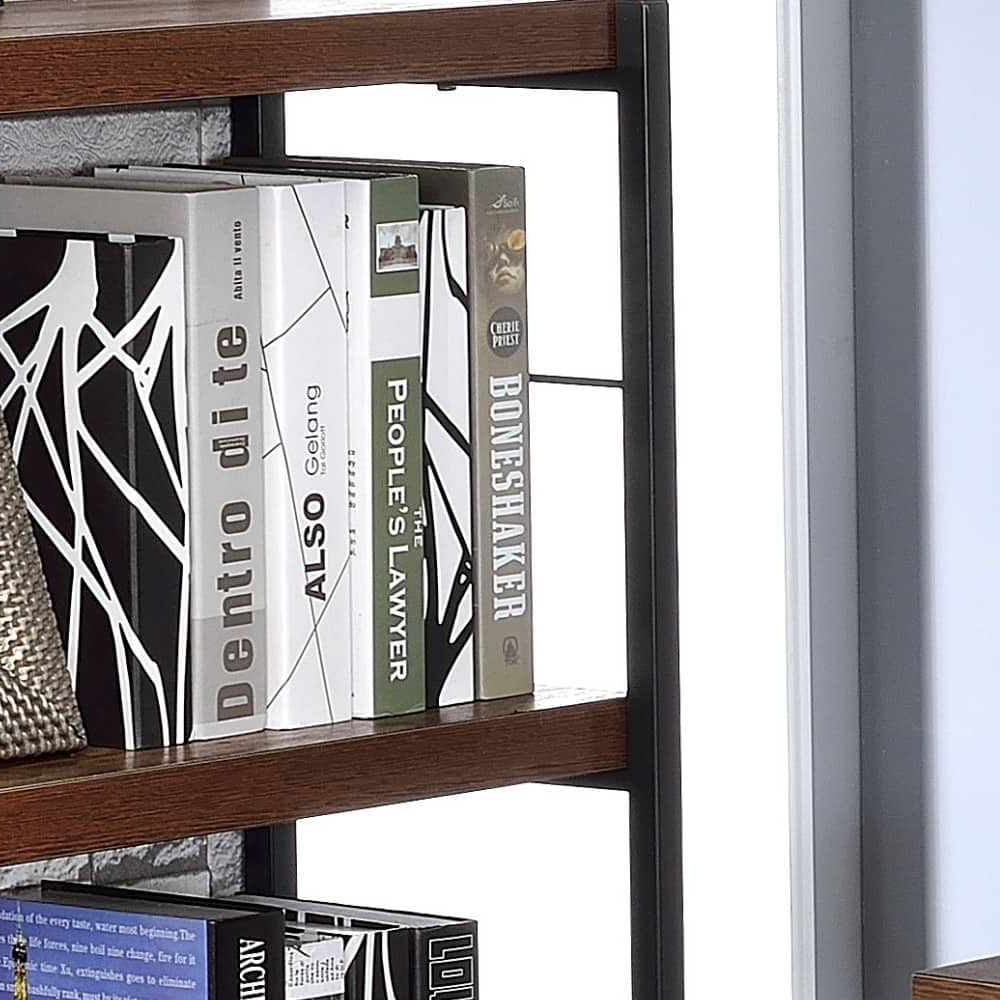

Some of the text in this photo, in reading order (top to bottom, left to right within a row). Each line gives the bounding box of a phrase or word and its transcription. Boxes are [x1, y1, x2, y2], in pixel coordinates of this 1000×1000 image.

[233, 221, 242, 253] vento
[490, 320, 520, 335] CHERIE
[492, 334, 520, 348] PRIEST
[303, 385, 327, 602] ALSO Gelang
[489, 373, 526, 622] BONESHAKER
[211, 325, 255, 722] Dentro di te
[387, 378, 409, 683] PEOPLE'S LAWYER
[413, 507, 423, 548] THE
[25, 912, 33, 922] of
[35, 913, 47, 924] the
[49, 916, 69, 929] every
[71, 917, 93, 931] taste,
[95, 920, 116, 932] water
[118, 924, 137, 934] most
[29, 935, 41, 947] life
[71, 941, 88, 952] nine
[90, 943, 105, 954] boil
[107, 945, 123, 957] nine
[158, 951, 171, 962] fire
[174, 953, 187, 964] for
[188, 954, 195, 965] it
[40, 961, 56, 972] time
[126, 973, 144, 983] goes
[147, 973, 155, 984] to
[159, 975, 196, 989] eliminate
